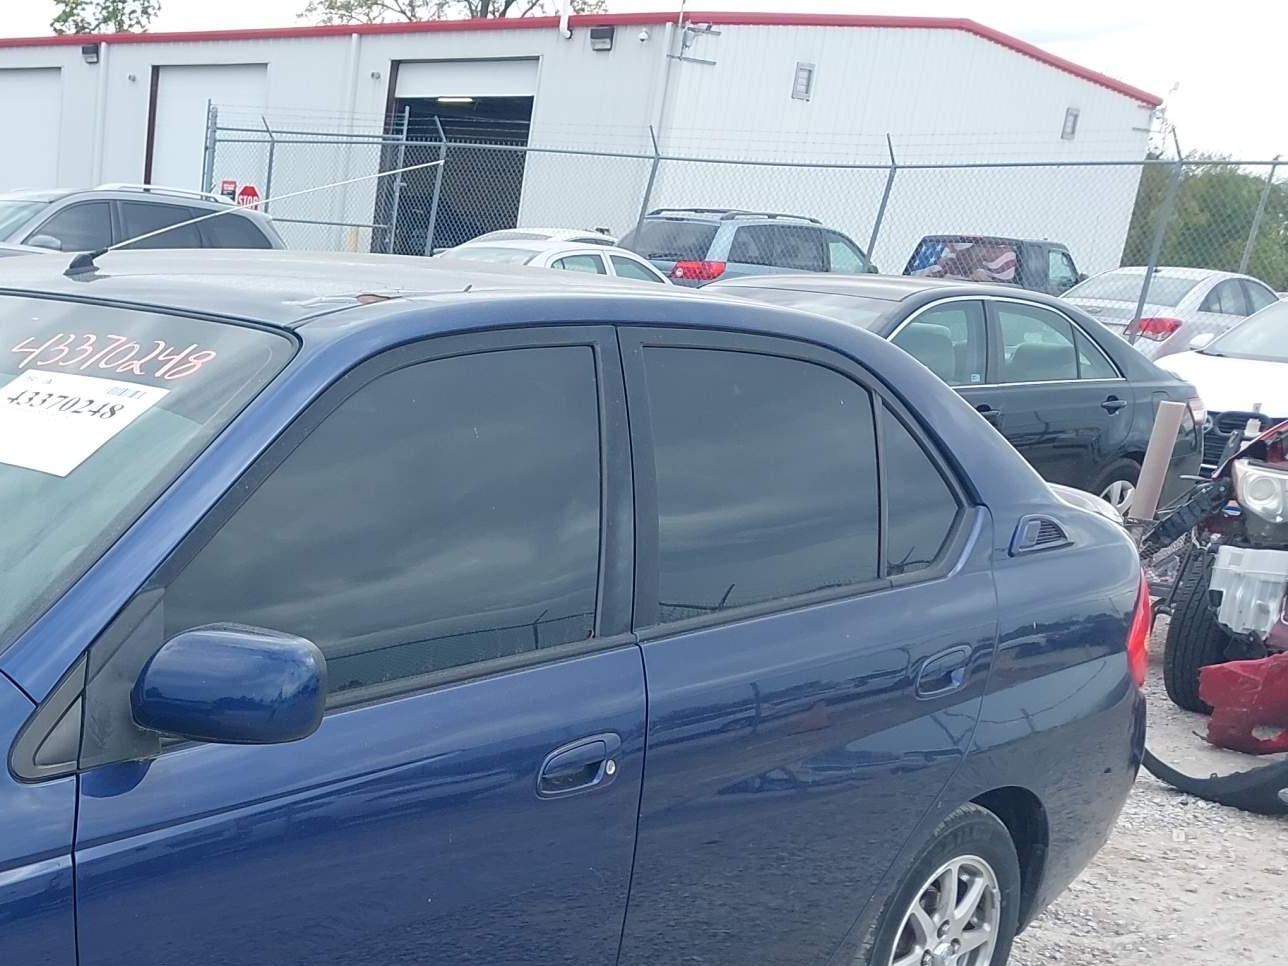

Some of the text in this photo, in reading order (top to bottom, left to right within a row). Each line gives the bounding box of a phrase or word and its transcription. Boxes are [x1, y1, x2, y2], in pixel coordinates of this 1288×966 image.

[239, 195, 258, 209] STOP
[12, 333, 217, 380] 43370248
[7, 390, 125, 420] 43370248
